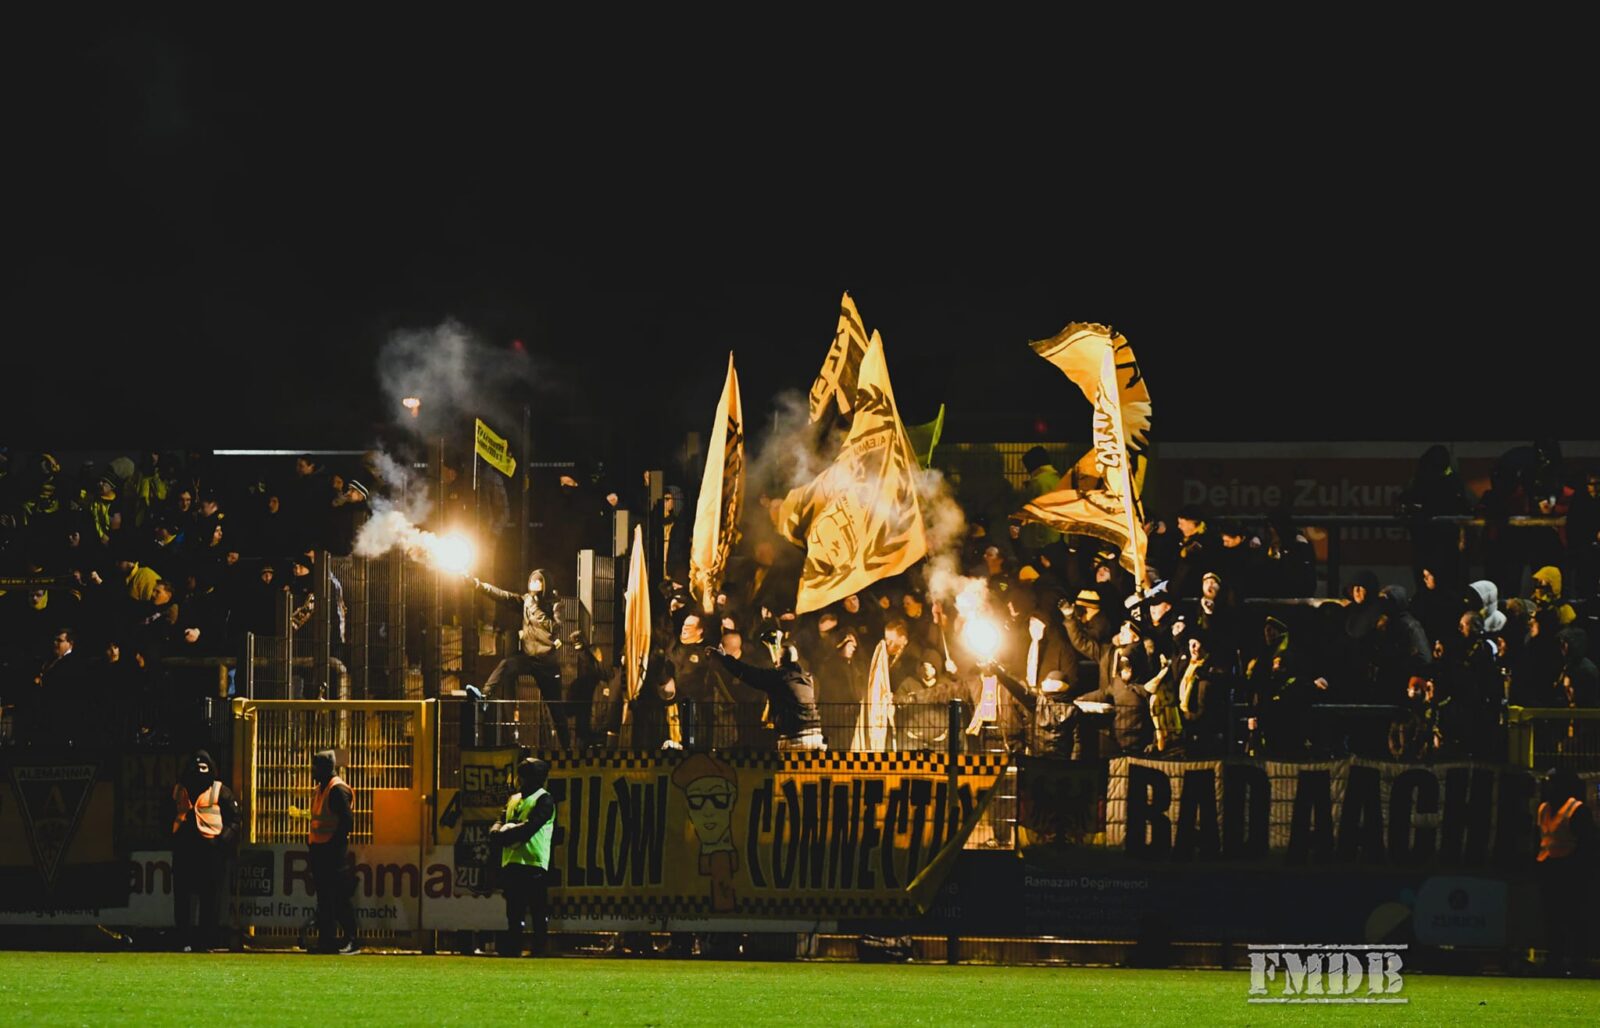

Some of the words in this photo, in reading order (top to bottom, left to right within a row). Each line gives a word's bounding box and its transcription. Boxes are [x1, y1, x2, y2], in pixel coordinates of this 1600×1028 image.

[1183, 478, 1282, 507] Deine
[1127, 764, 1272, 862] BAD
[546, 775, 671, 887] ELLOW
[457, 866, 480, 887] ZU
[1024, 875, 1078, 888] Ramazan
[278, 902, 298, 917] für
[356, 903, 398, 918] macht
